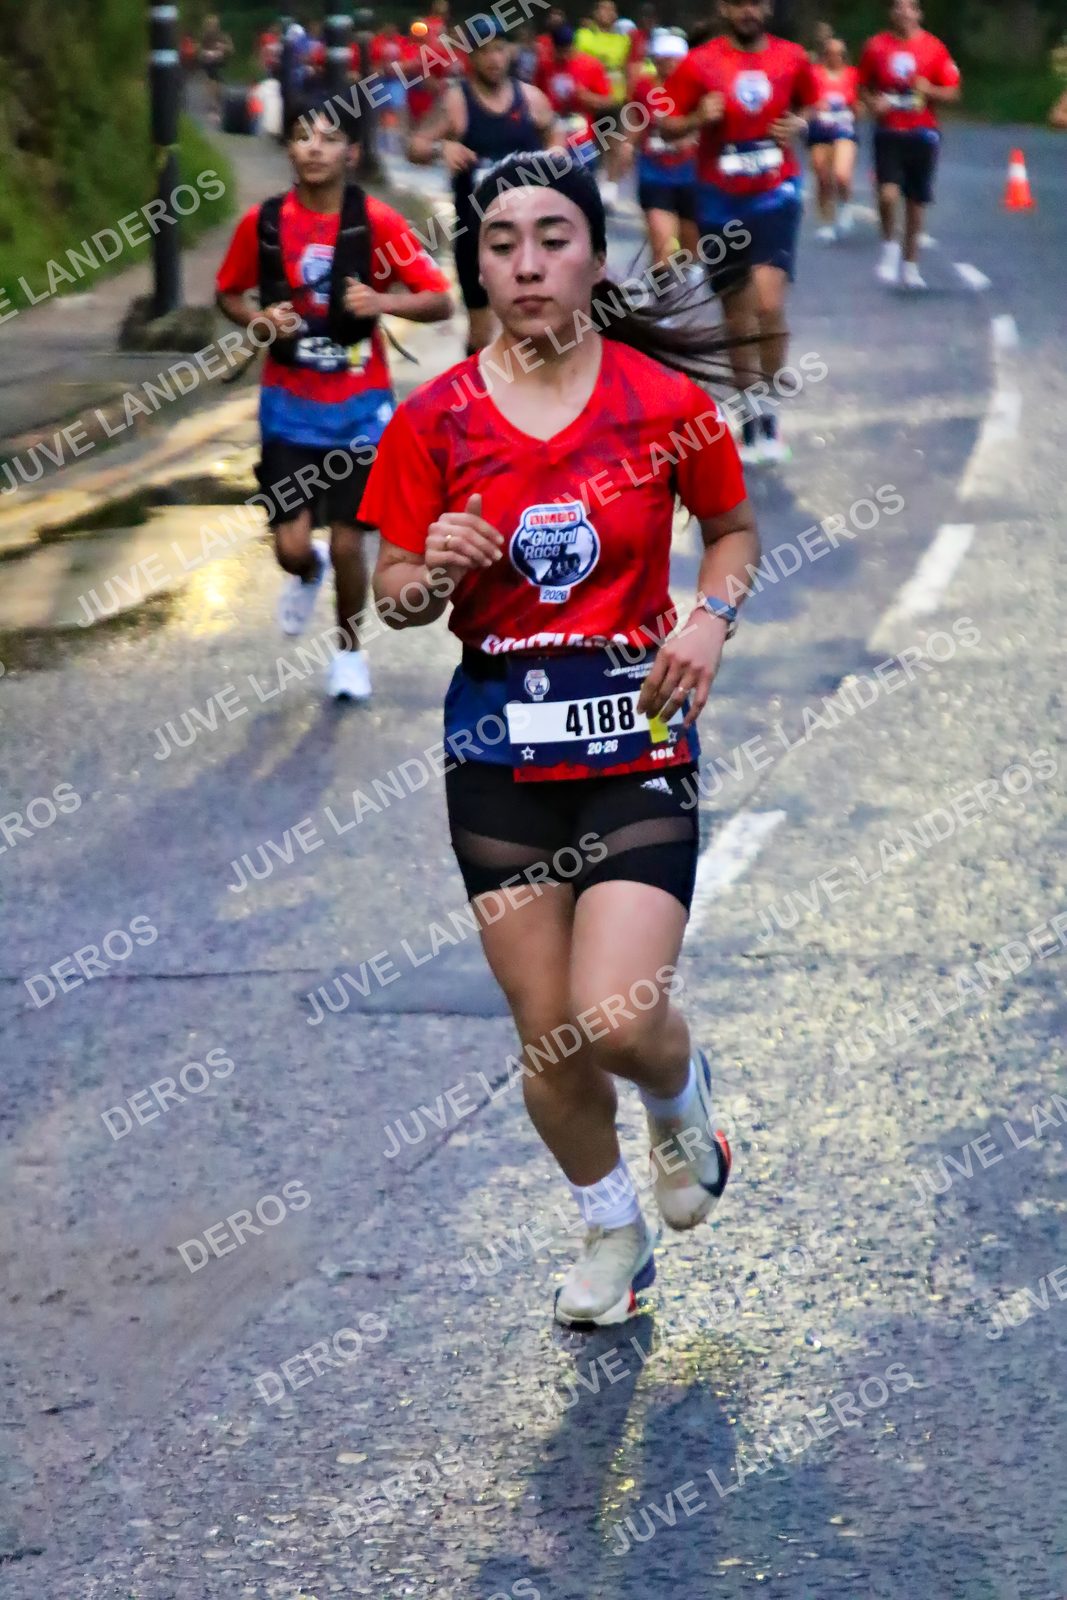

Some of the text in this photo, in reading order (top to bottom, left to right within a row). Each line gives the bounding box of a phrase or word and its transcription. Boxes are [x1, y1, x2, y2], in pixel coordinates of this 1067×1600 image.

[531, 527, 577, 547] Global
[524, 544, 561, 561] Race
[565, 696, 635, 737] 4188
[650, 746, 675, 761] 10K
